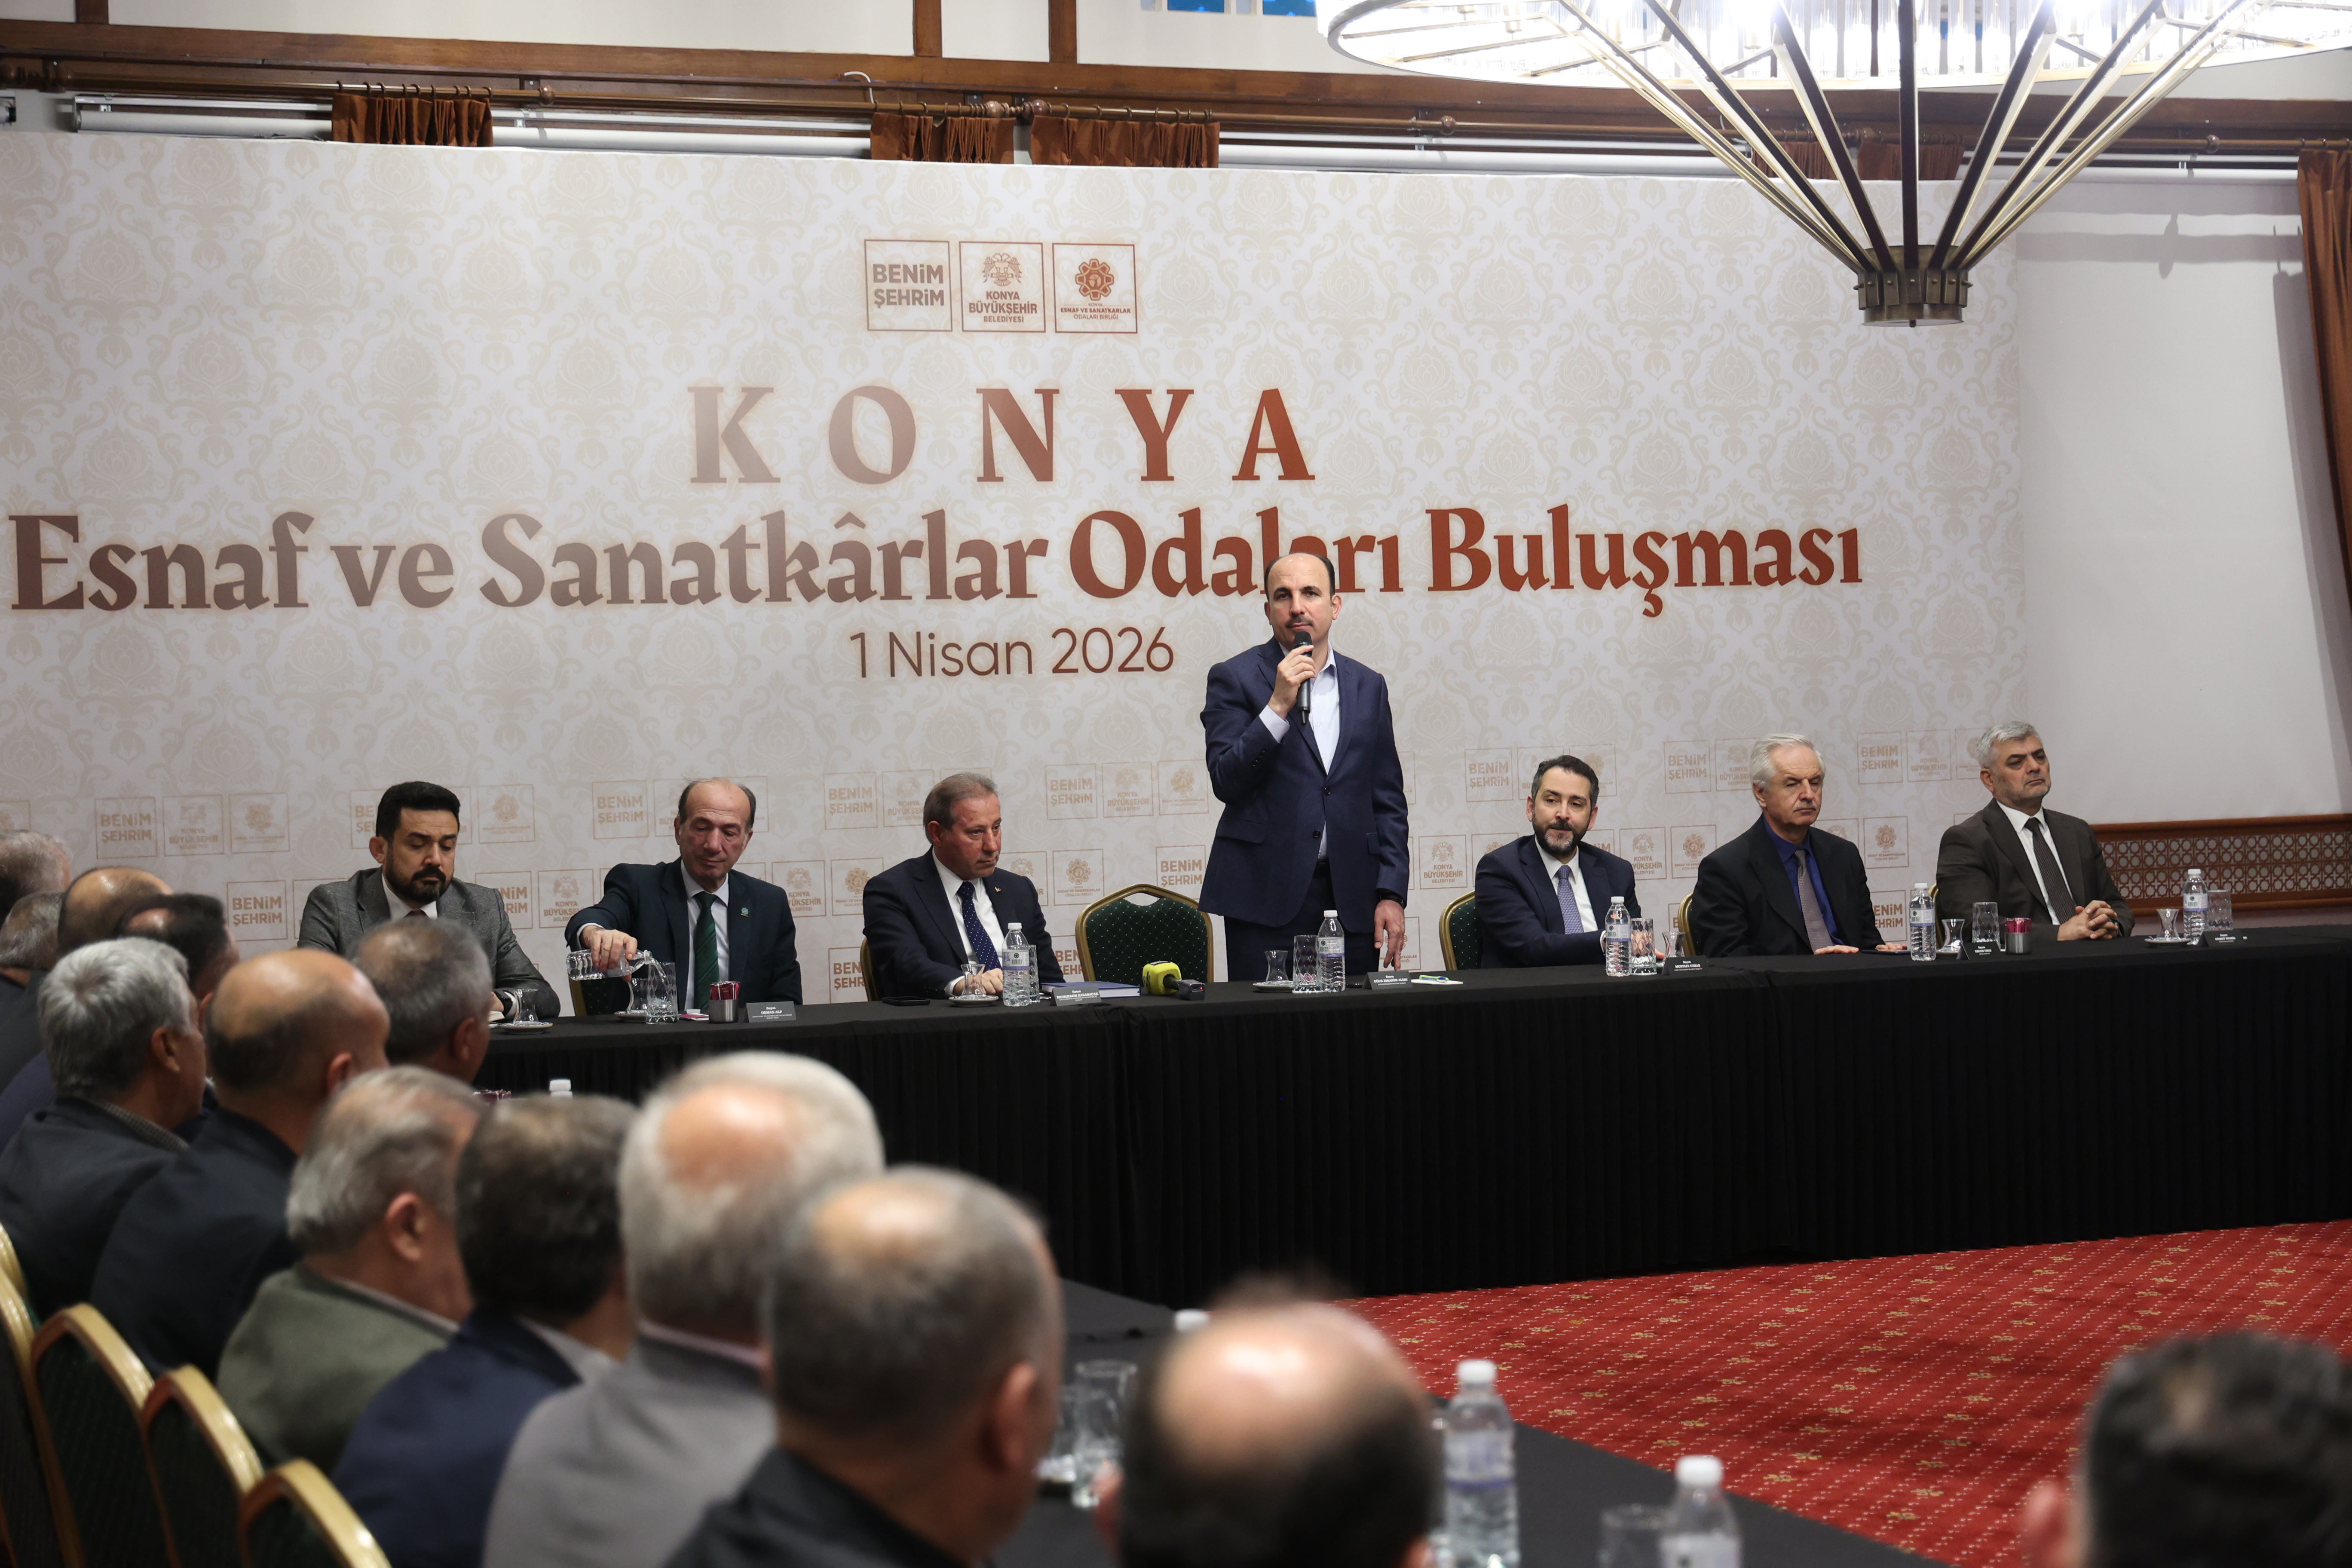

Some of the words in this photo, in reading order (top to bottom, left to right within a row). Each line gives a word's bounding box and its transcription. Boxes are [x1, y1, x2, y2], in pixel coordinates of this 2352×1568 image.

[986, 291, 1020, 300] KONYA
[969, 300, 1038, 315] BÜYÜKŞEHİR
[687, 386, 1316, 485] KONYA
[8, 511, 315, 612] Esnaf
[330, 540, 455, 607] ve
[479, 508, 1048, 609] Sanatkârlar
[1425, 503, 1863, 617] Buluşması
[850, 632, 867, 678] 1
[889, 631, 1032, 677] Nisan
[1051, 627, 1174, 674] 2026
[1424, 869, 1463, 878] BÜYÜKŞEHİR
[833, 962, 862, 975] BEN
[834, 977, 865, 990] ŞEHR
